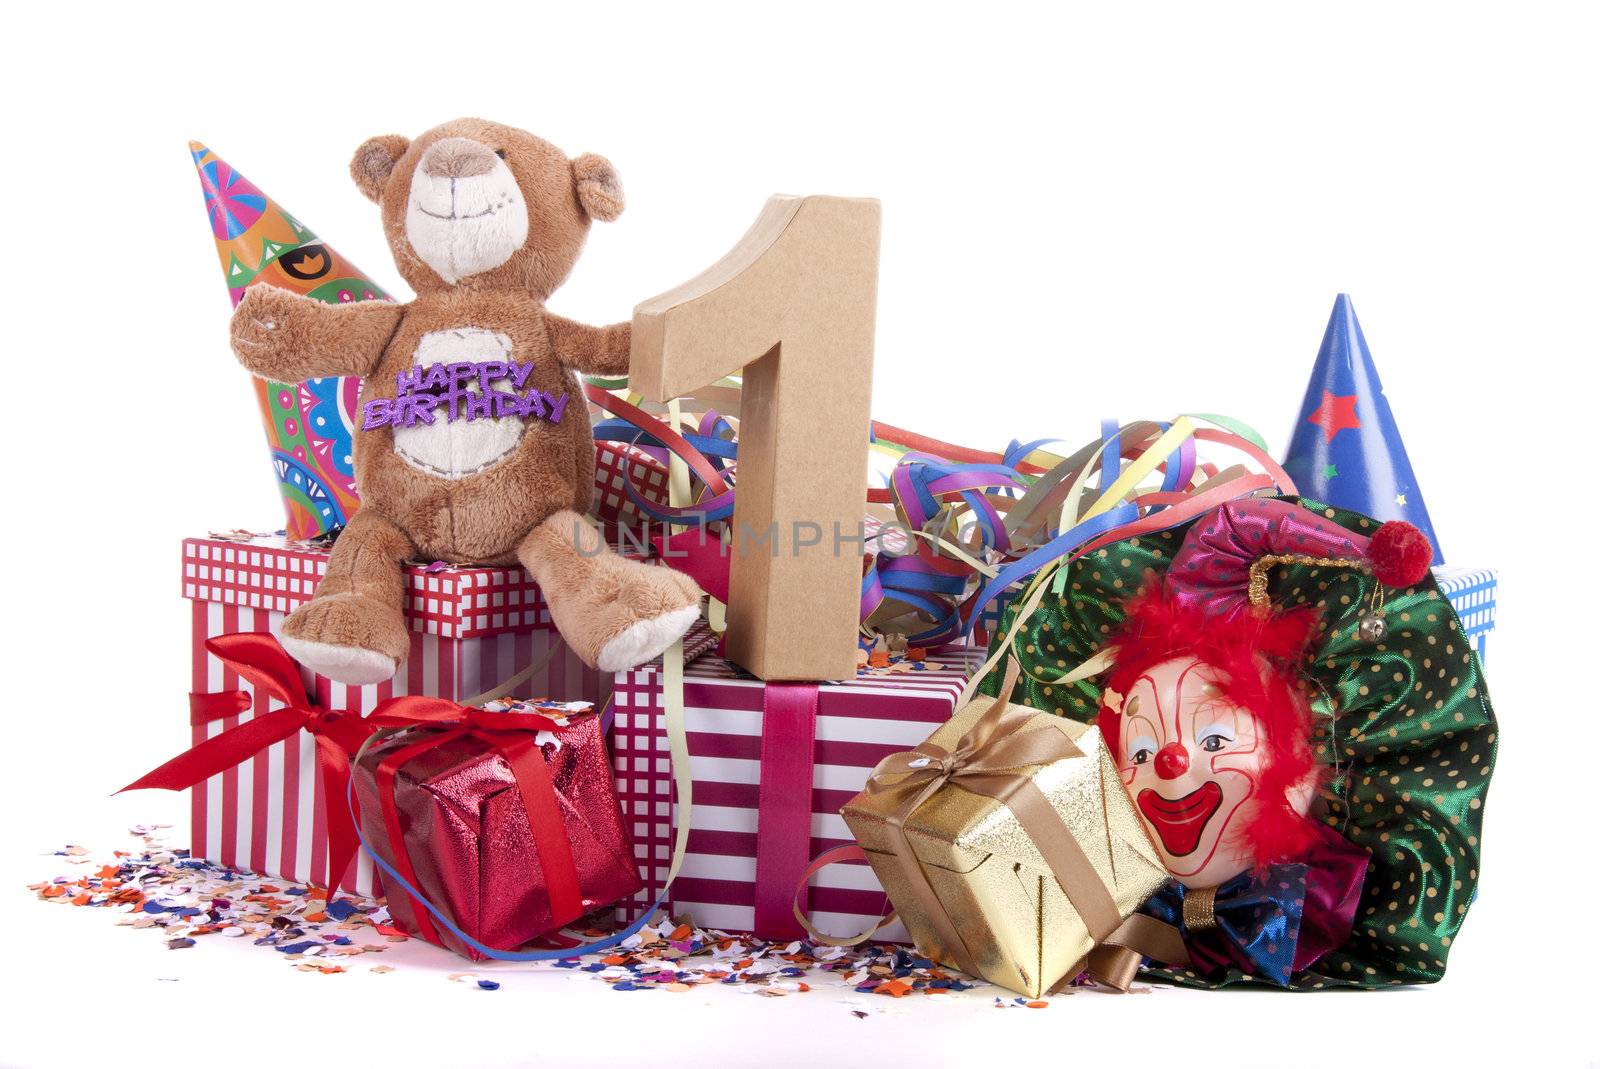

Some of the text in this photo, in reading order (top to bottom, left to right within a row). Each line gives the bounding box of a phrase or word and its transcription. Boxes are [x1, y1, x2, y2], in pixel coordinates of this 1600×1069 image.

[397, 360, 535, 397] HAPPY
[362, 388, 569, 431] BIRTHDAY
[629, 194, 882, 681] 1
